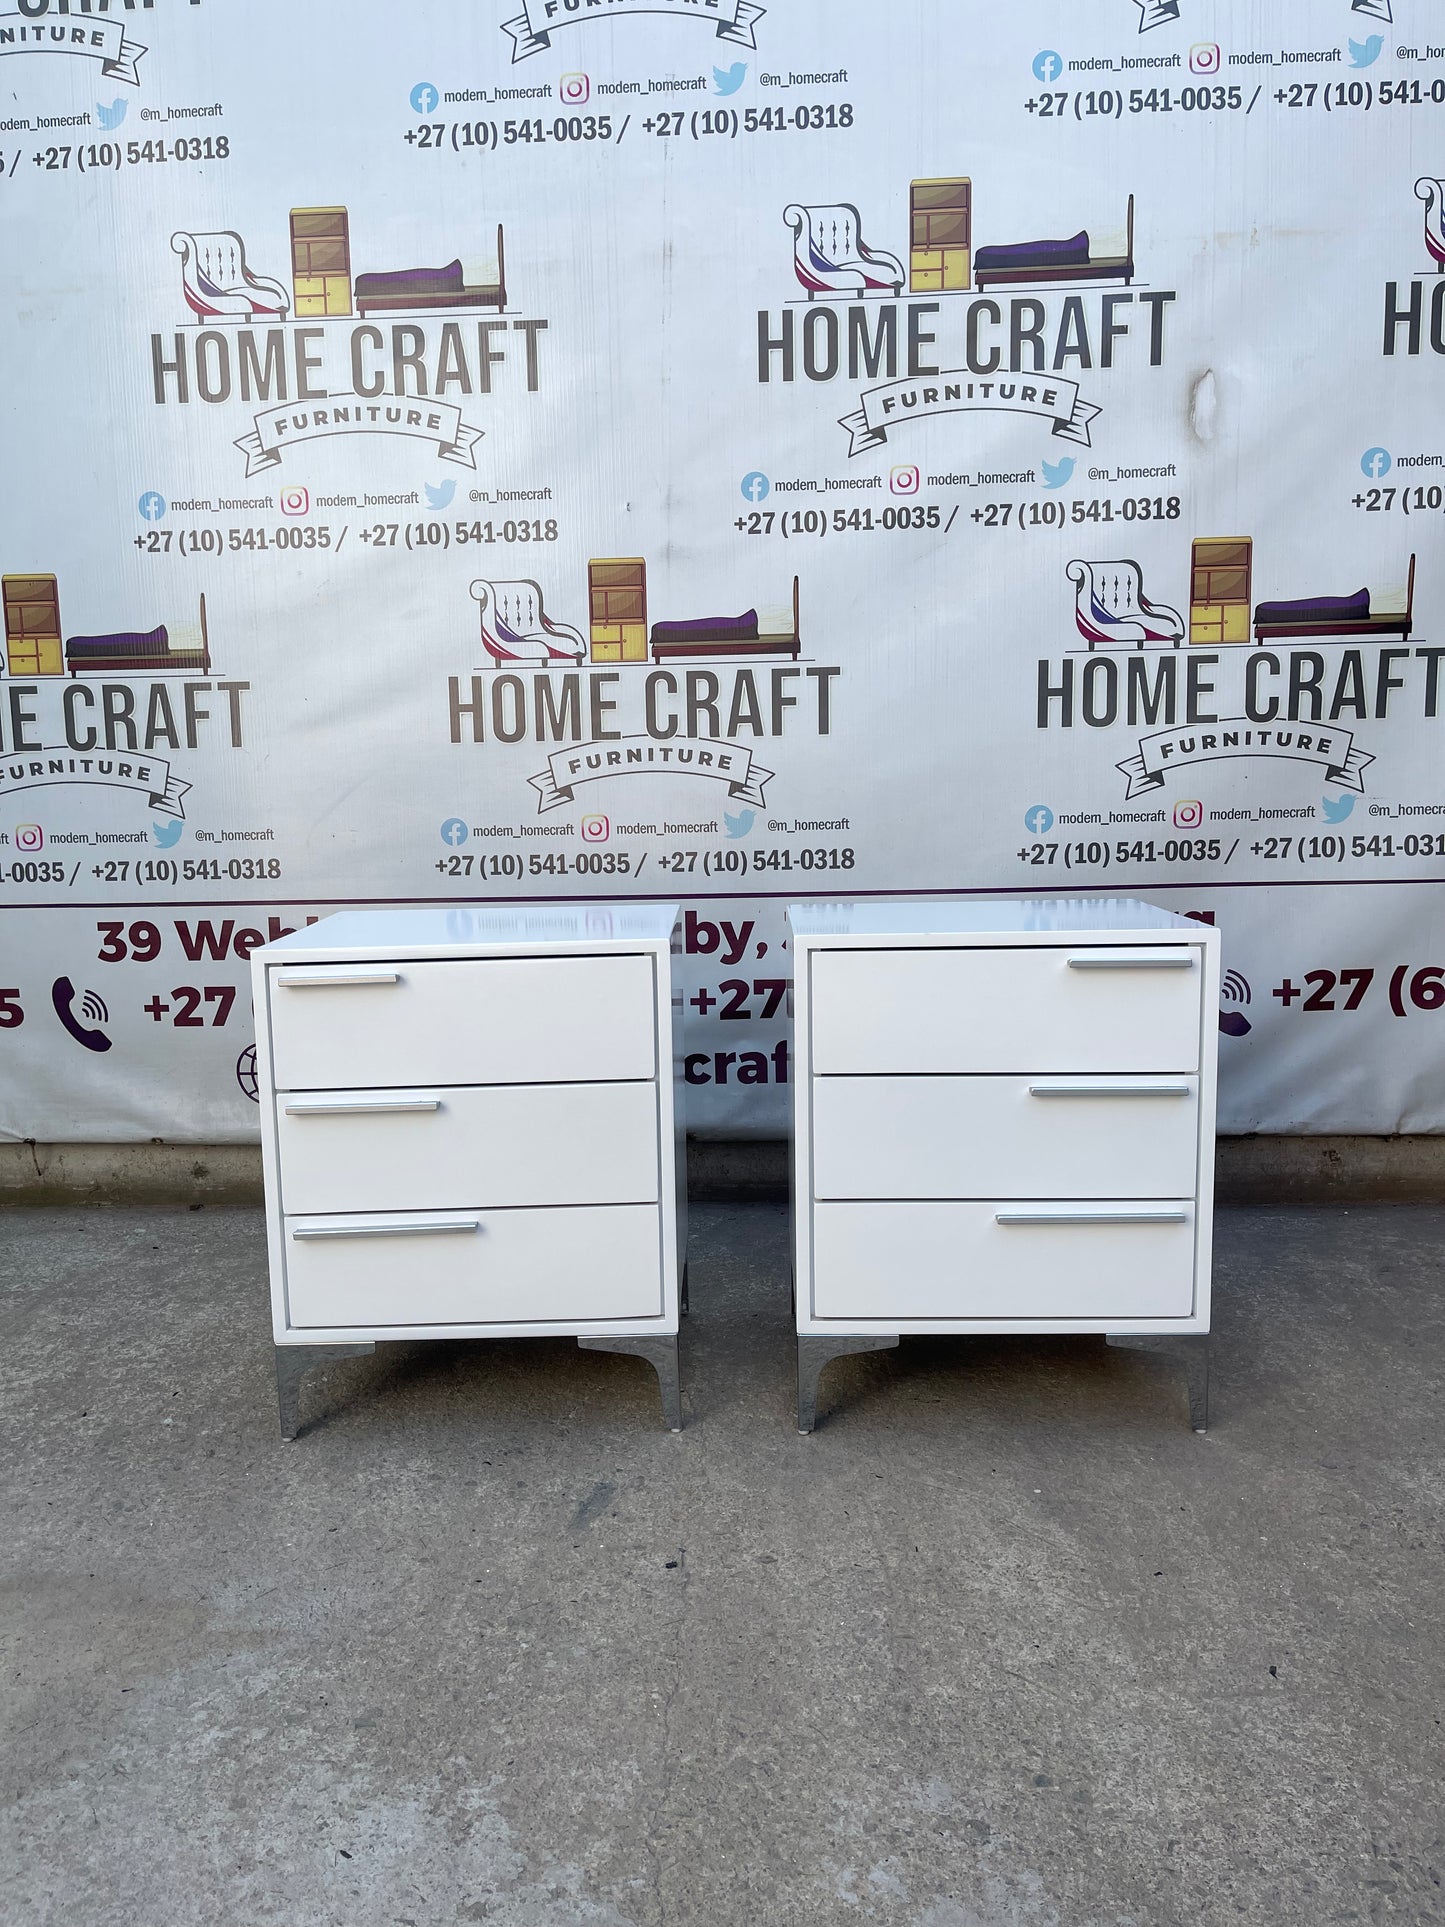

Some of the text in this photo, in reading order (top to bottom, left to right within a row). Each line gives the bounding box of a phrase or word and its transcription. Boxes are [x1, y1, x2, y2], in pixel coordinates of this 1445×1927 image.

[759, 68, 849, 88] @m_homecraft
[140, 102, 224, 123] @m_homecraft
[1024, 92, 1069, 117] +27
[1074, 90, 1123, 121] (10)
[1128, 85, 1242, 114] 541-0035
[1273, 83, 1318, 108] +27
[1323, 81, 1373, 112] (10)
[403, 123, 446, 149] +27
[451, 121, 498, 152] (10)
[503, 115, 612, 145] 541-0035
[642, 111, 685, 137] +27
[690, 109, 739, 141] (10)
[743, 103, 854, 133] 541-0318
[32, 146, 72, 170] +27
[77, 142, 122, 173] (10)
[126, 135, 230, 165] 541-0318
[756, 290, 1177, 383] HOME CRAFT
[150, 319, 549, 405] HOME CRAFT
[881, 382, 1058, 415] FURNITURE
[274, 405, 442, 436] FURNITURE
[1087, 463, 1177, 482] @m_homecraft
[468, 486, 553, 504] @m_homecraft
[1351, 487, 1397, 512] +27
[733, 511, 776, 535] +27
[781, 510, 827, 539] (10)
[832, 505, 941, 532] 541-0035
[970, 503, 1013, 527] +27
[1018, 501, 1066, 531] (10)
[1071, 496, 1181, 524] 541-0318
[133, 530, 173, 553] +27
[178, 529, 224, 557] (10)
[228, 526, 331, 551] 541-0035
[359, 523, 399, 547] +27
[405, 522, 450, 551] (10)
[455, 518, 559, 545] 541-0318
[447, 665, 841, 744] HOME CRAFT
[1036, 647, 1445, 729] HOME CRAFT
[62, 681, 251, 752] CRAFT
[567, 746, 734, 775] FURNITURE
[1160, 730, 1333, 759] FURNITURE
[195, 828, 275, 844] @m_homecraft
[767, 817, 850, 834] @m_homecraft
[434, 855, 475, 876] +27
[479, 854, 524, 881] (10)
[528, 852, 631, 876] 541-0035
[658, 851, 698, 873] +27
[703, 850, 748, 877] (10)
[752, 847, 855, 872] 541-0318
[1016, 843, 1059, 865] +27
[1064, 842, 1110, 869] (10)
[1115, 839, 1221, 863] 541-0035
[1250, 837, 1293, 859] +27
[1297, 836, 1346, 863] (10)
[91, 860, 130, 882] +27
[135, 860, 178, 886] (10)
[182, 858, 282, 881] 541-0318
[96, 916, 319, 963] 39 Web
[143, 986, 236, 1027] +27
[689, 978, 789, 1021] +27
[1272, 968, 1375, 1012] +27
